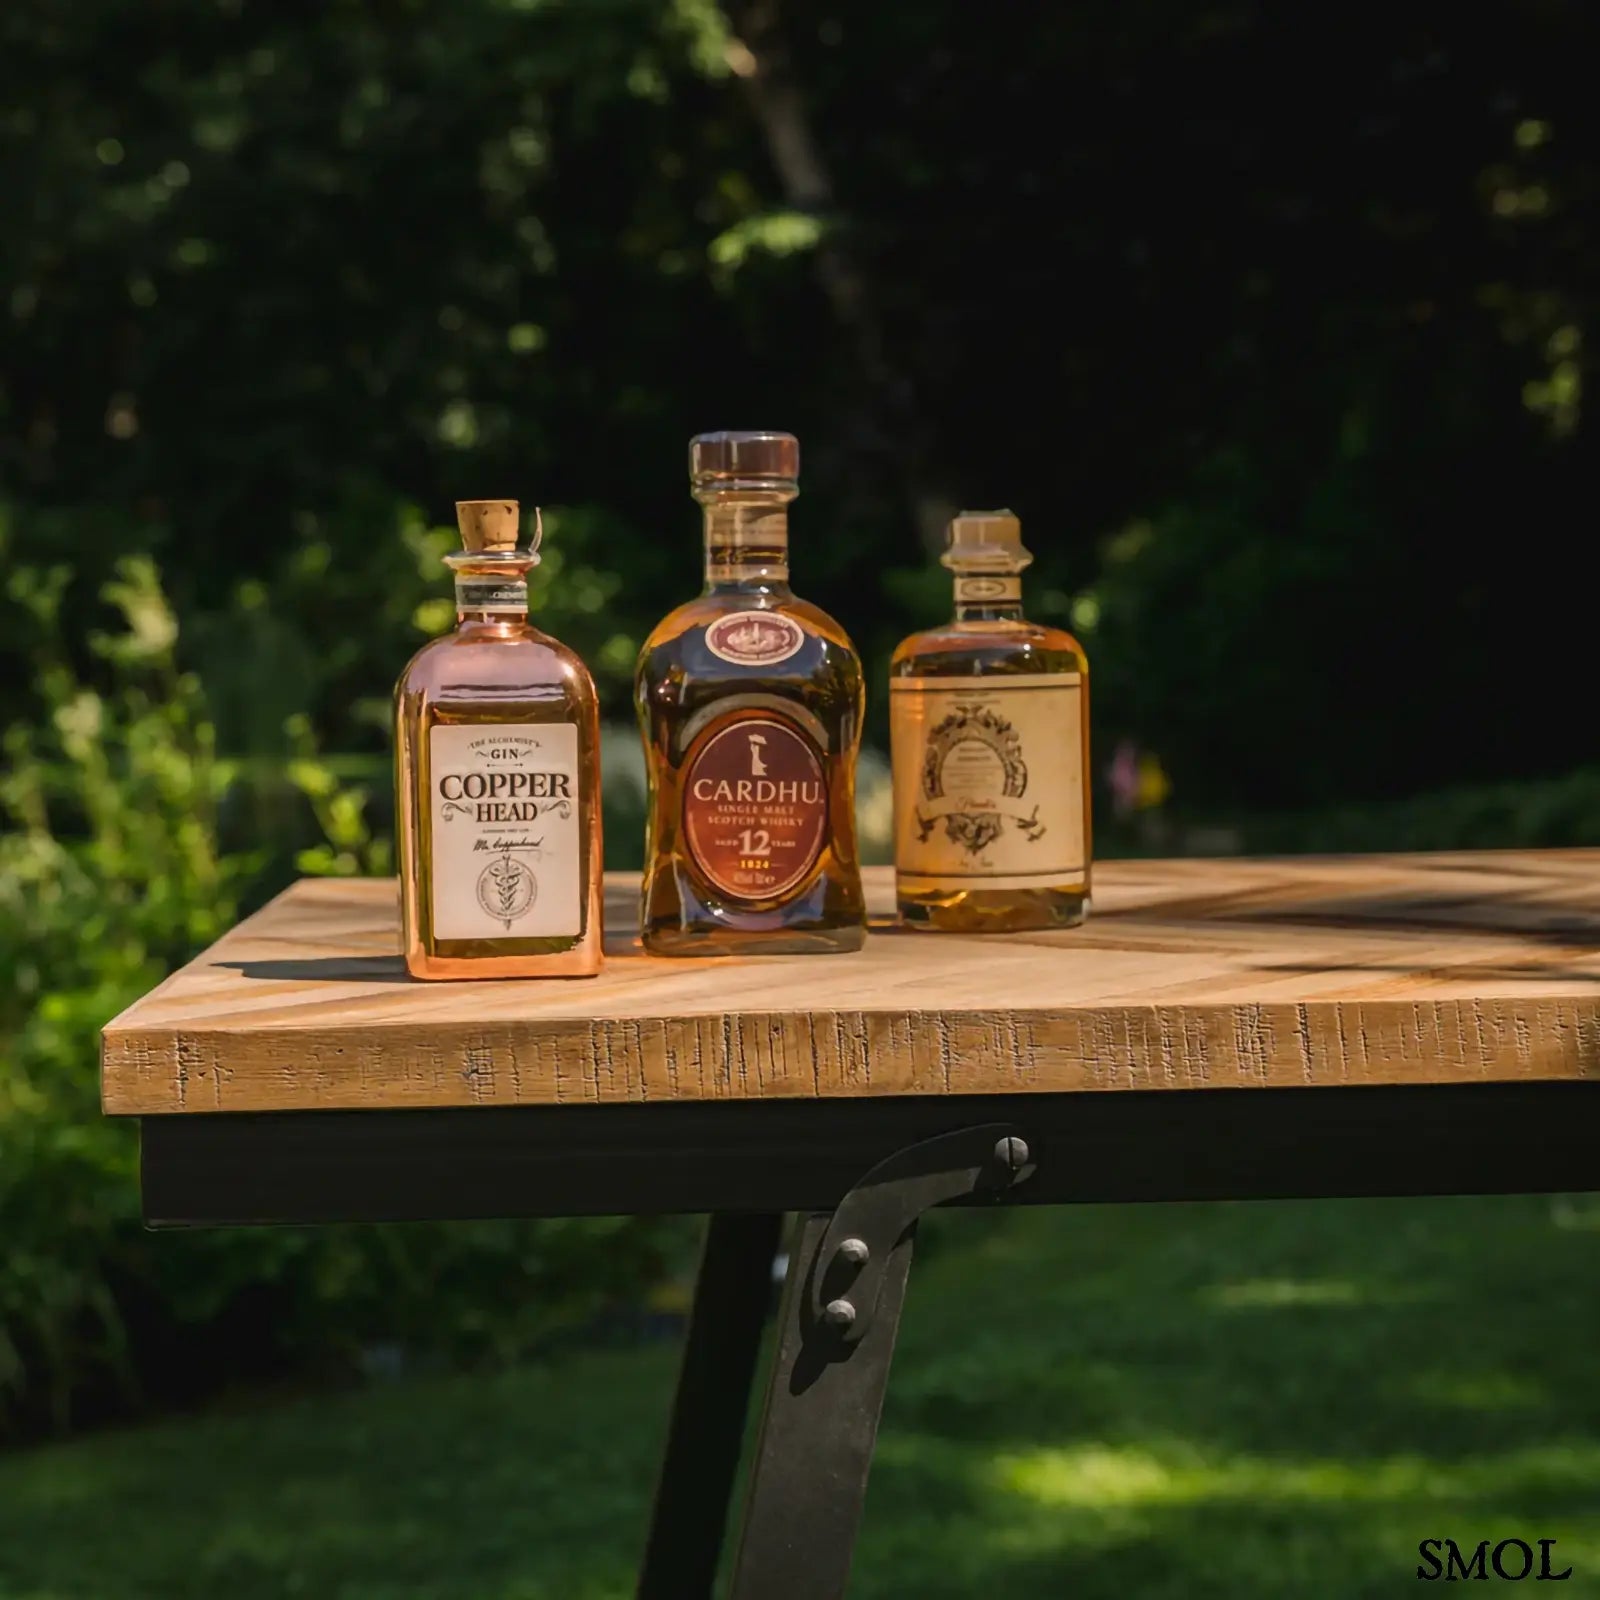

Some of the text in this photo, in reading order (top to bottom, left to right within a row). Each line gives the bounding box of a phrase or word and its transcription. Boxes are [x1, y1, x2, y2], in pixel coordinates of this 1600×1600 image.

[491, 748, 519, 760] GIN
[439, 773, 571, 801] COPPER
[693, 778, 821, 804] CARDHU
[476, 802, 538, 823] HEAD
[718, 804, 794, 815] SINGLE MALT
[708, 815, 804, 828] SCOTCH WHISKY
[738, 829, 772, 856] 12
[740, 859, 770, 869] 1824
